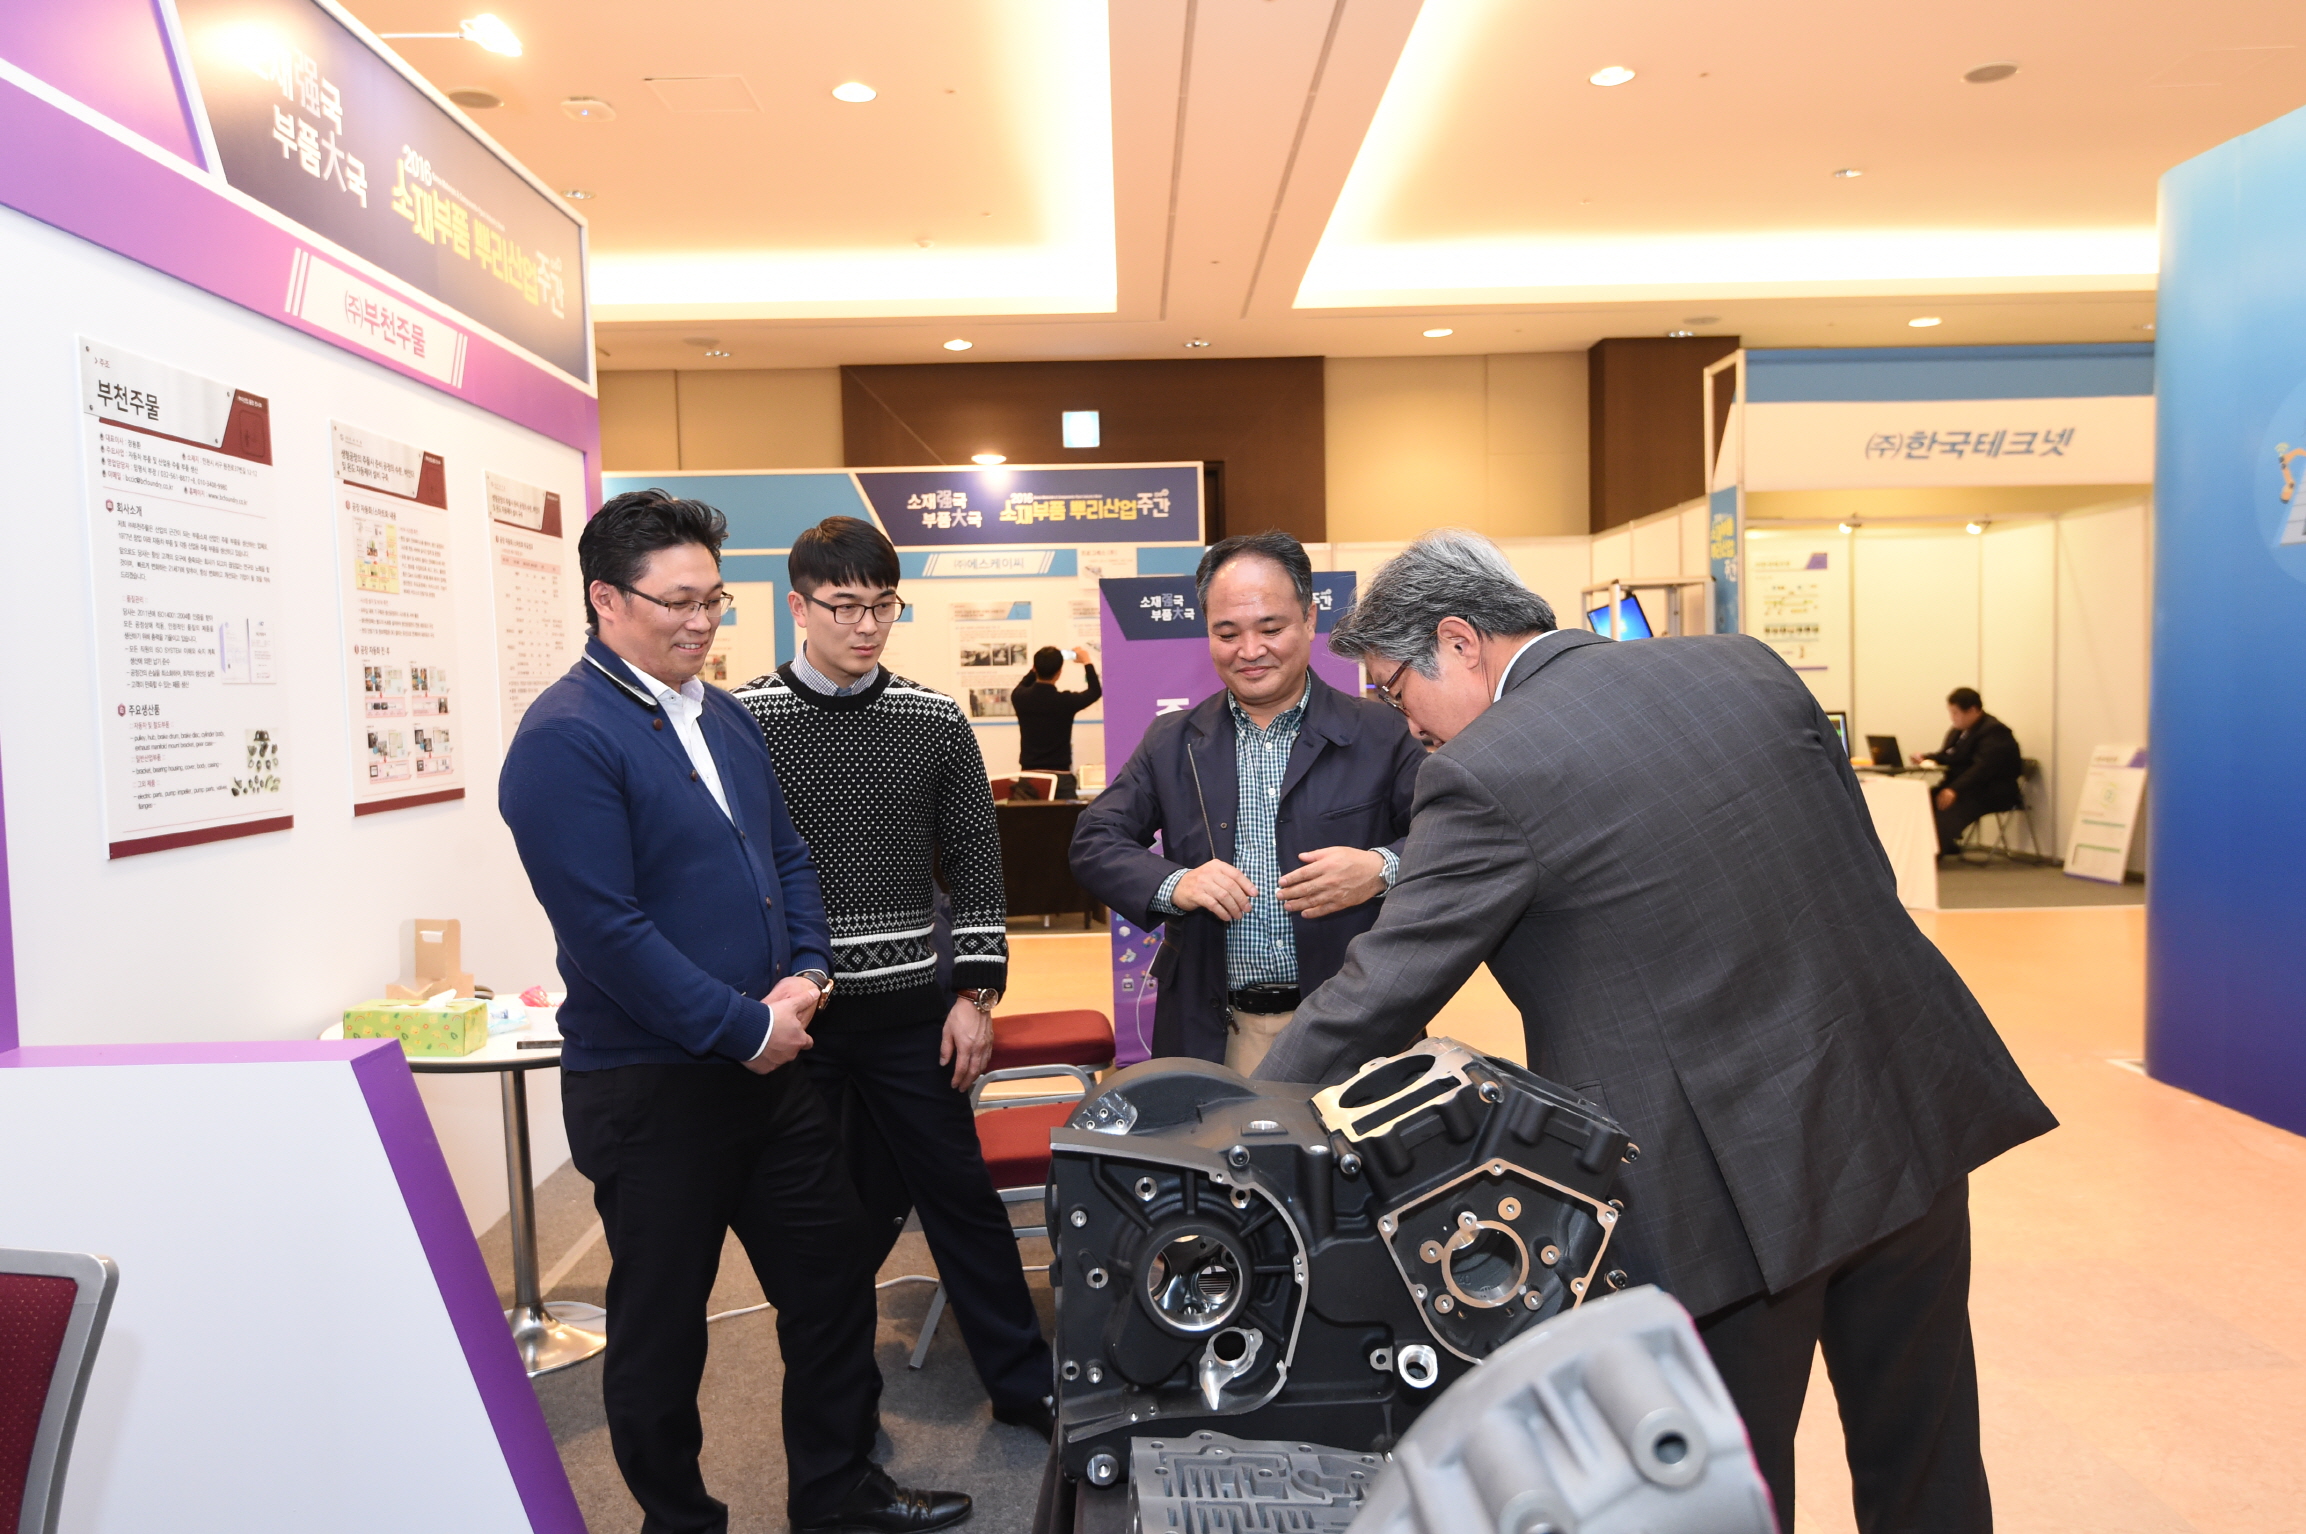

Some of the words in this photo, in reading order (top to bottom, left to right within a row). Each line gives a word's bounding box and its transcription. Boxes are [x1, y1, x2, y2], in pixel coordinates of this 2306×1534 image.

[273, 103, 368, 209] 부품大국
[402, 144, 434, 187] 2016
[391, 157, 471, 261] 소재부품
[474, 217, 540, 307] 뿌리산업
[537, 250, 564, 320] 주간
[96, 377, 160, 421] 부천주물
[1865, 427, 2075, 460] (주)한국테크넷
[116, 501, 142, 516] 회사소개
[1000, 498, 1066, 525] 소재부품
[1069, 499, 1137, 521] 뿌리산업
[1137, 489, 1171, 518] 주간
[1010, 492, 1034, 504] 2016
[922, 509, 982, 529] 부품大국
[1140, 593, 1184, 609] 소재强국
[1151, 608, 1195, 622] 부품大국
[128, 704, 160, 716] 주요생산품
